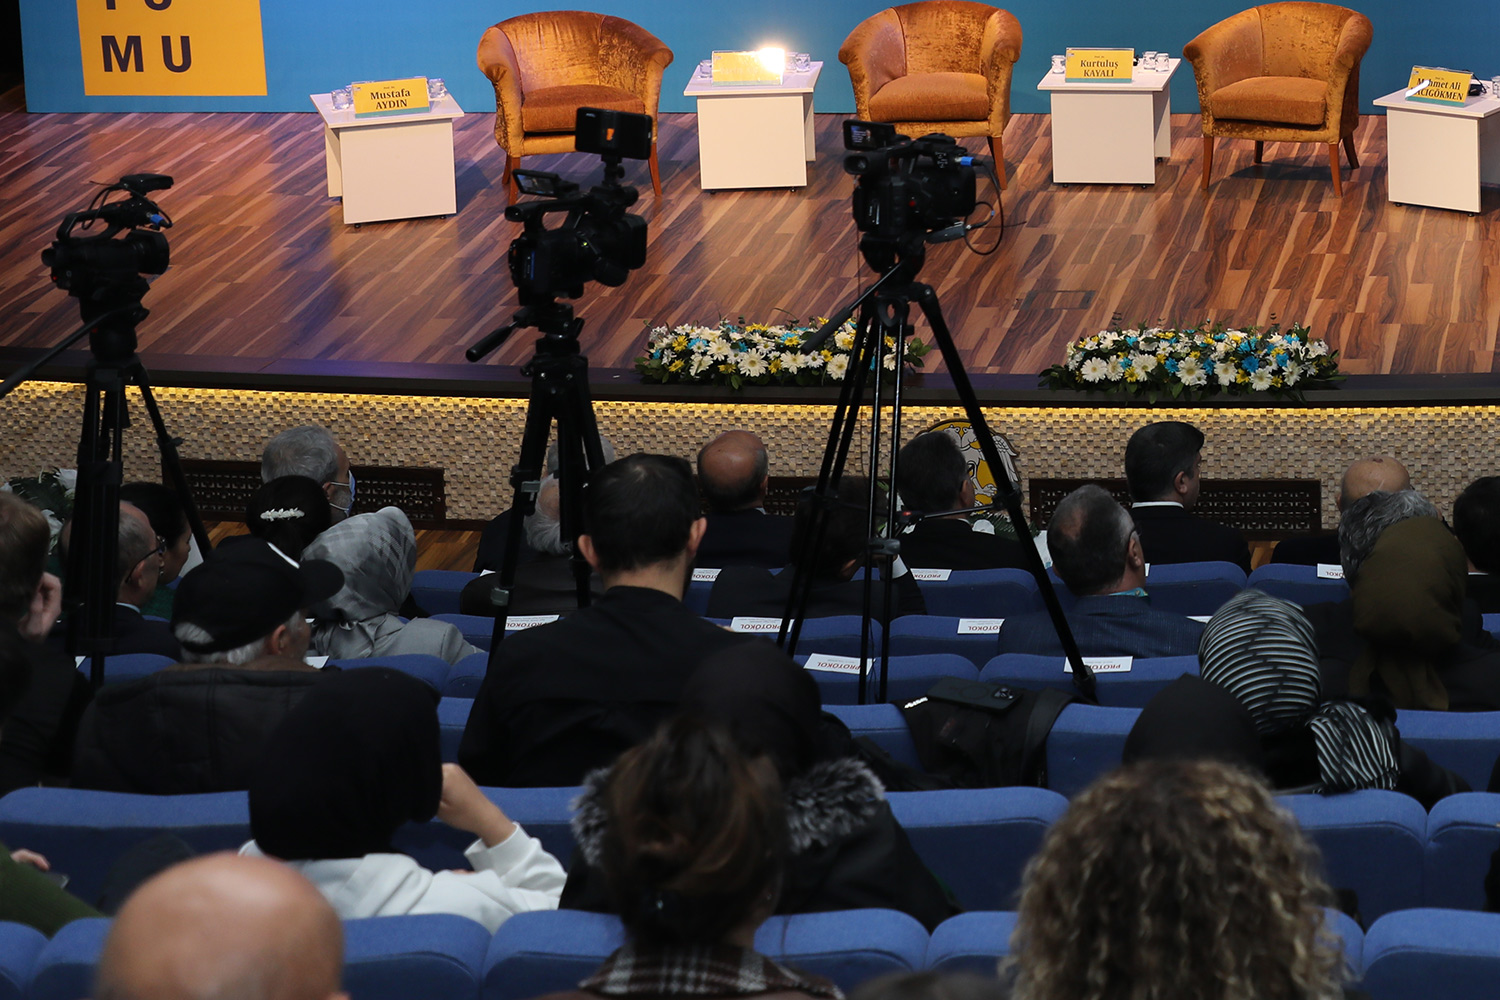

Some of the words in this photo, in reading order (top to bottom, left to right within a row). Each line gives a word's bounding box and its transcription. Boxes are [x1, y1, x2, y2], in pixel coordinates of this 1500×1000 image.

[1080, 59, 1119, 69] Kurtuluş
[1083, 69, 1114, 78] KAYALI
[1416, 77, 1449, 88] Mhmet
[1449, 82, 1461, 90] Ali
[370, 88, 411, 100] Mustafa
[1412, 87, 1464, 100] ACIGÖKMEN
[376, 99, 408, 110] AYDIN
[506, 621, 546, 629] ROTOKOL
[967, 624, 1001, 632] OTOKOL
[817, 662, 861, 670] PROTOKOL
